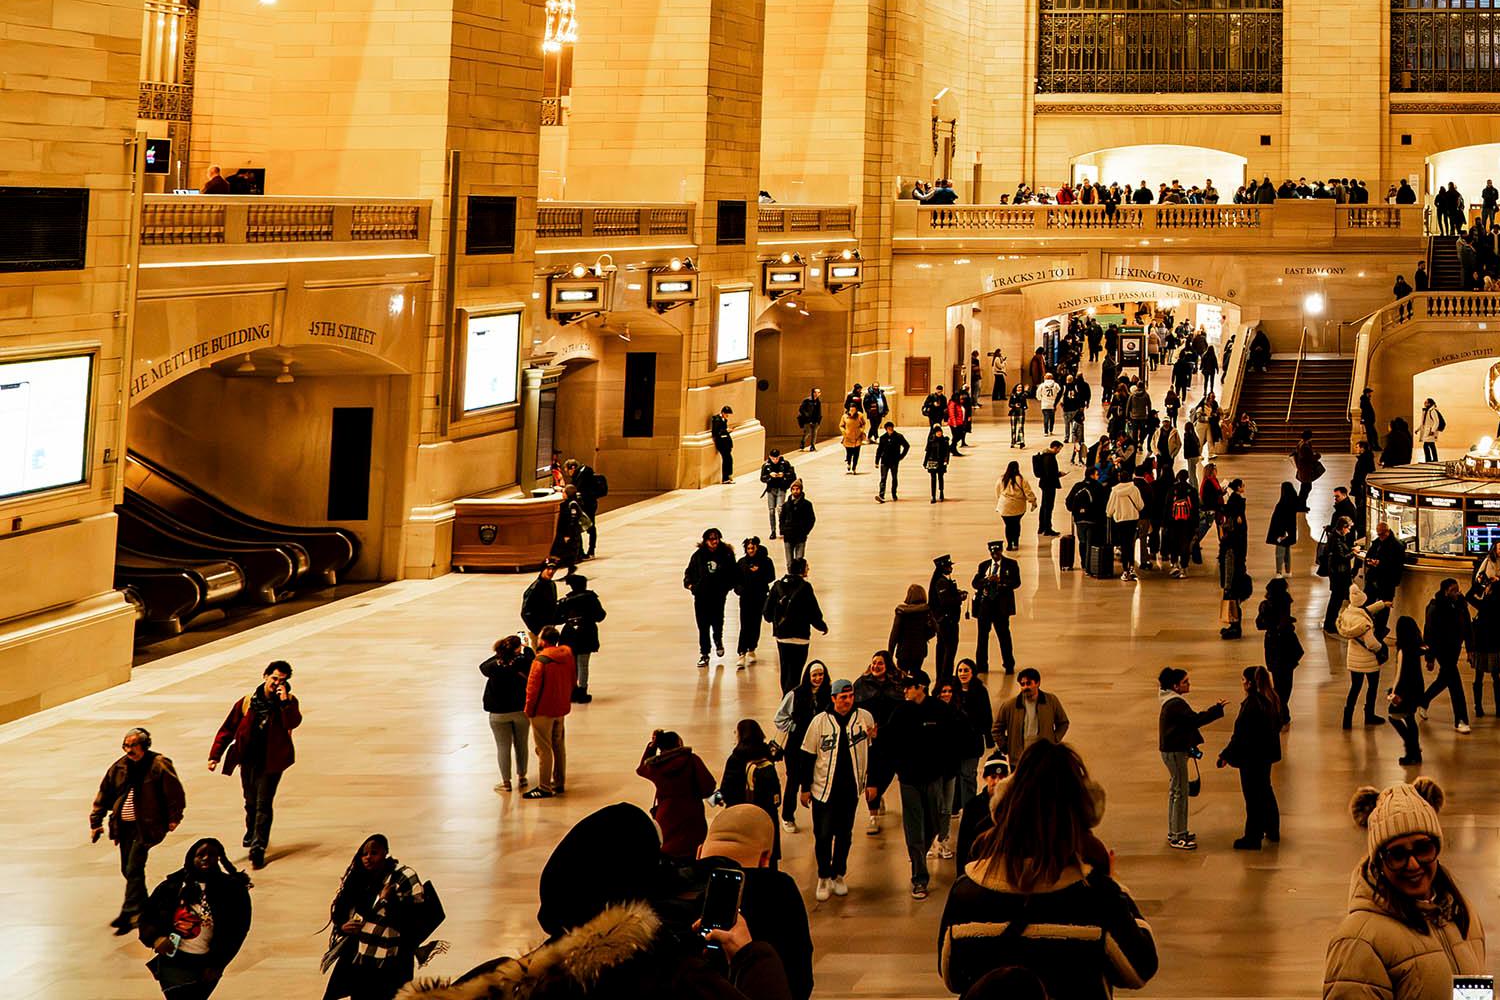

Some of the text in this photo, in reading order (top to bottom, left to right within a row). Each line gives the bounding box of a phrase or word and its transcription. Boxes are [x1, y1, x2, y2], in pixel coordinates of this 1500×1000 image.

[992, 272, 1034, 288] TRACKS
[1036, 271, 1046, 280] 21
[1048, 268, 1064, 278] TO
[1114, 267, 1204, 288] LEXINGTON AVE
[1284, 267, 1346, 275] EAST BALCONY
[1057, 299, 1081, 310] 42ND
[1083, 293, 1115, 305] STREET
[1119, 290, 1155, 300] PASSAGE
[308, 321, 376, 345] 45TH STREET
[129, 323, 270, 397] HE METLIFE BUILDING
[1432, 353, 1459, 365] TRACKS
